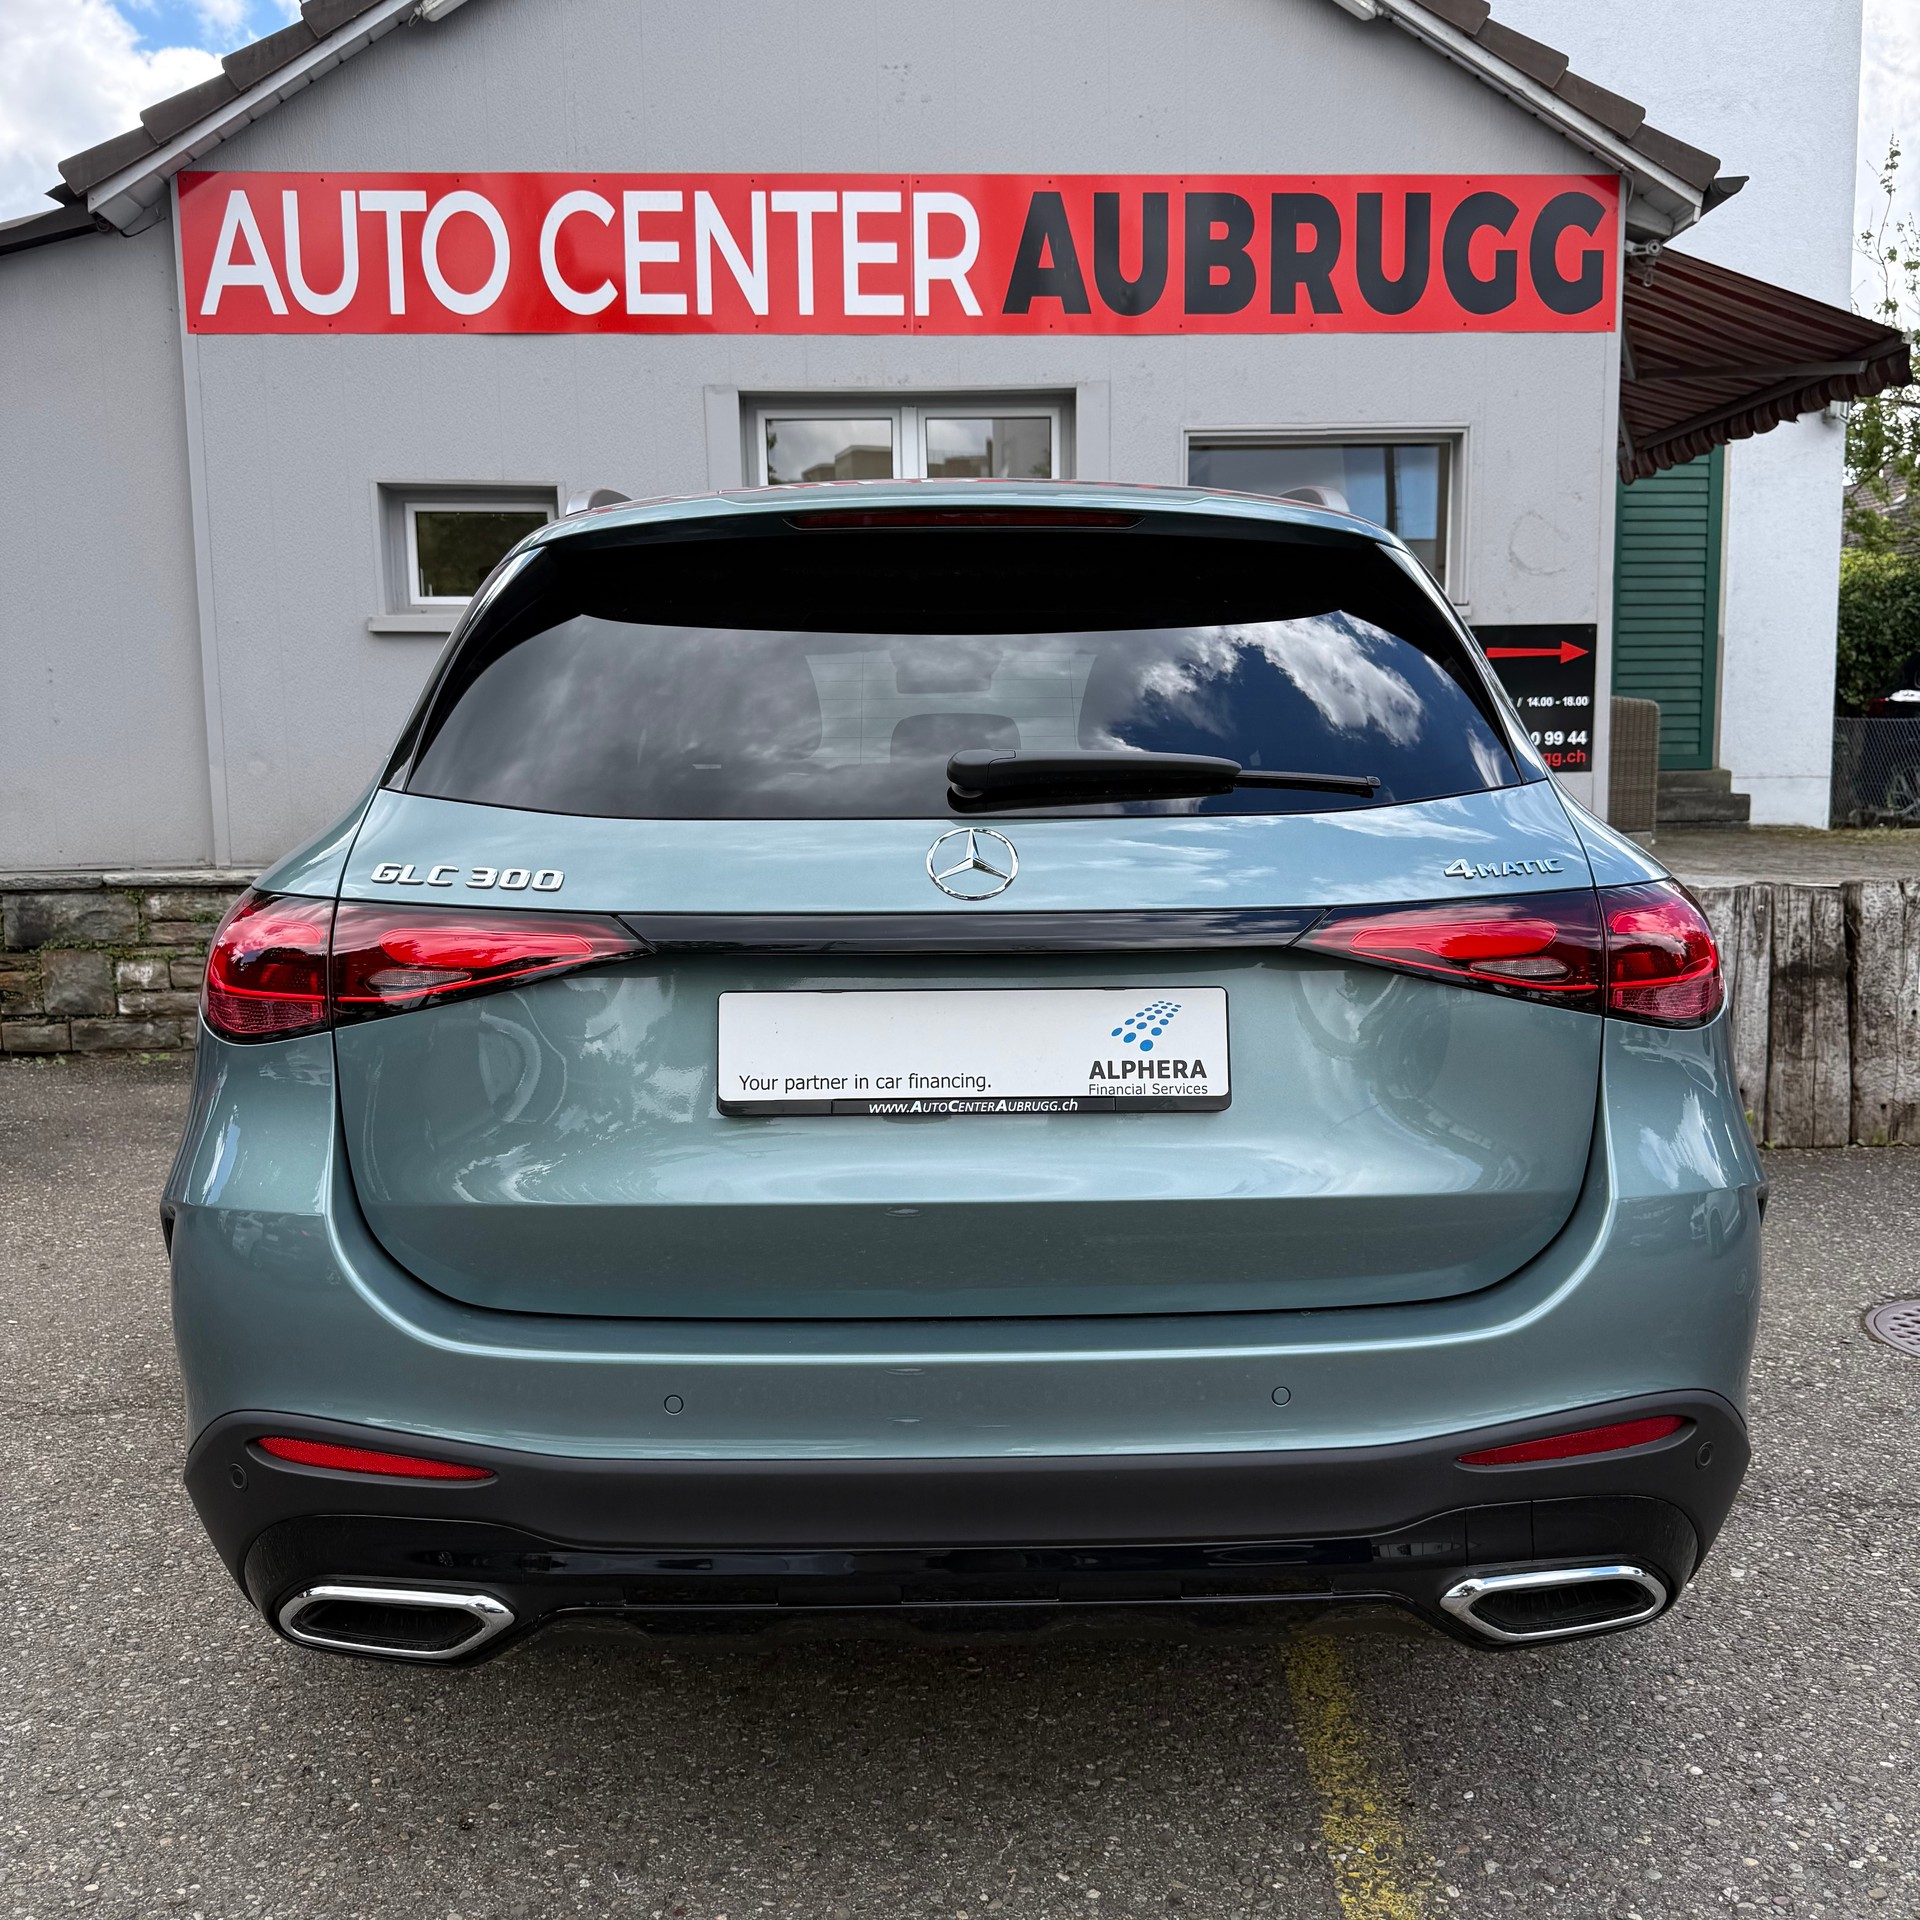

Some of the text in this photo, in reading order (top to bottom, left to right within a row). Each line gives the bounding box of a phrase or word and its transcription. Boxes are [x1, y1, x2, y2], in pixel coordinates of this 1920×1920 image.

[200, 190, 1606, 316] AUTO CENTER AUBRUGG
[1527, 696, 1554, 707] 14.00
[1562, 696, 1589, 707] 18.00
[1544, 731, 1565, 746] 99
[1567, 730, 1588, 746] 44
[370, 863, 565, 892] GLC 300
[1444, 858, 1565, 879] 4MATIC
[1089, 1059, 1207, 1080] ALPHERA
[739, 1073, 992, 1093] Your partner in car financing.
[1089, 1082, 1208, 1095] Financial Services
